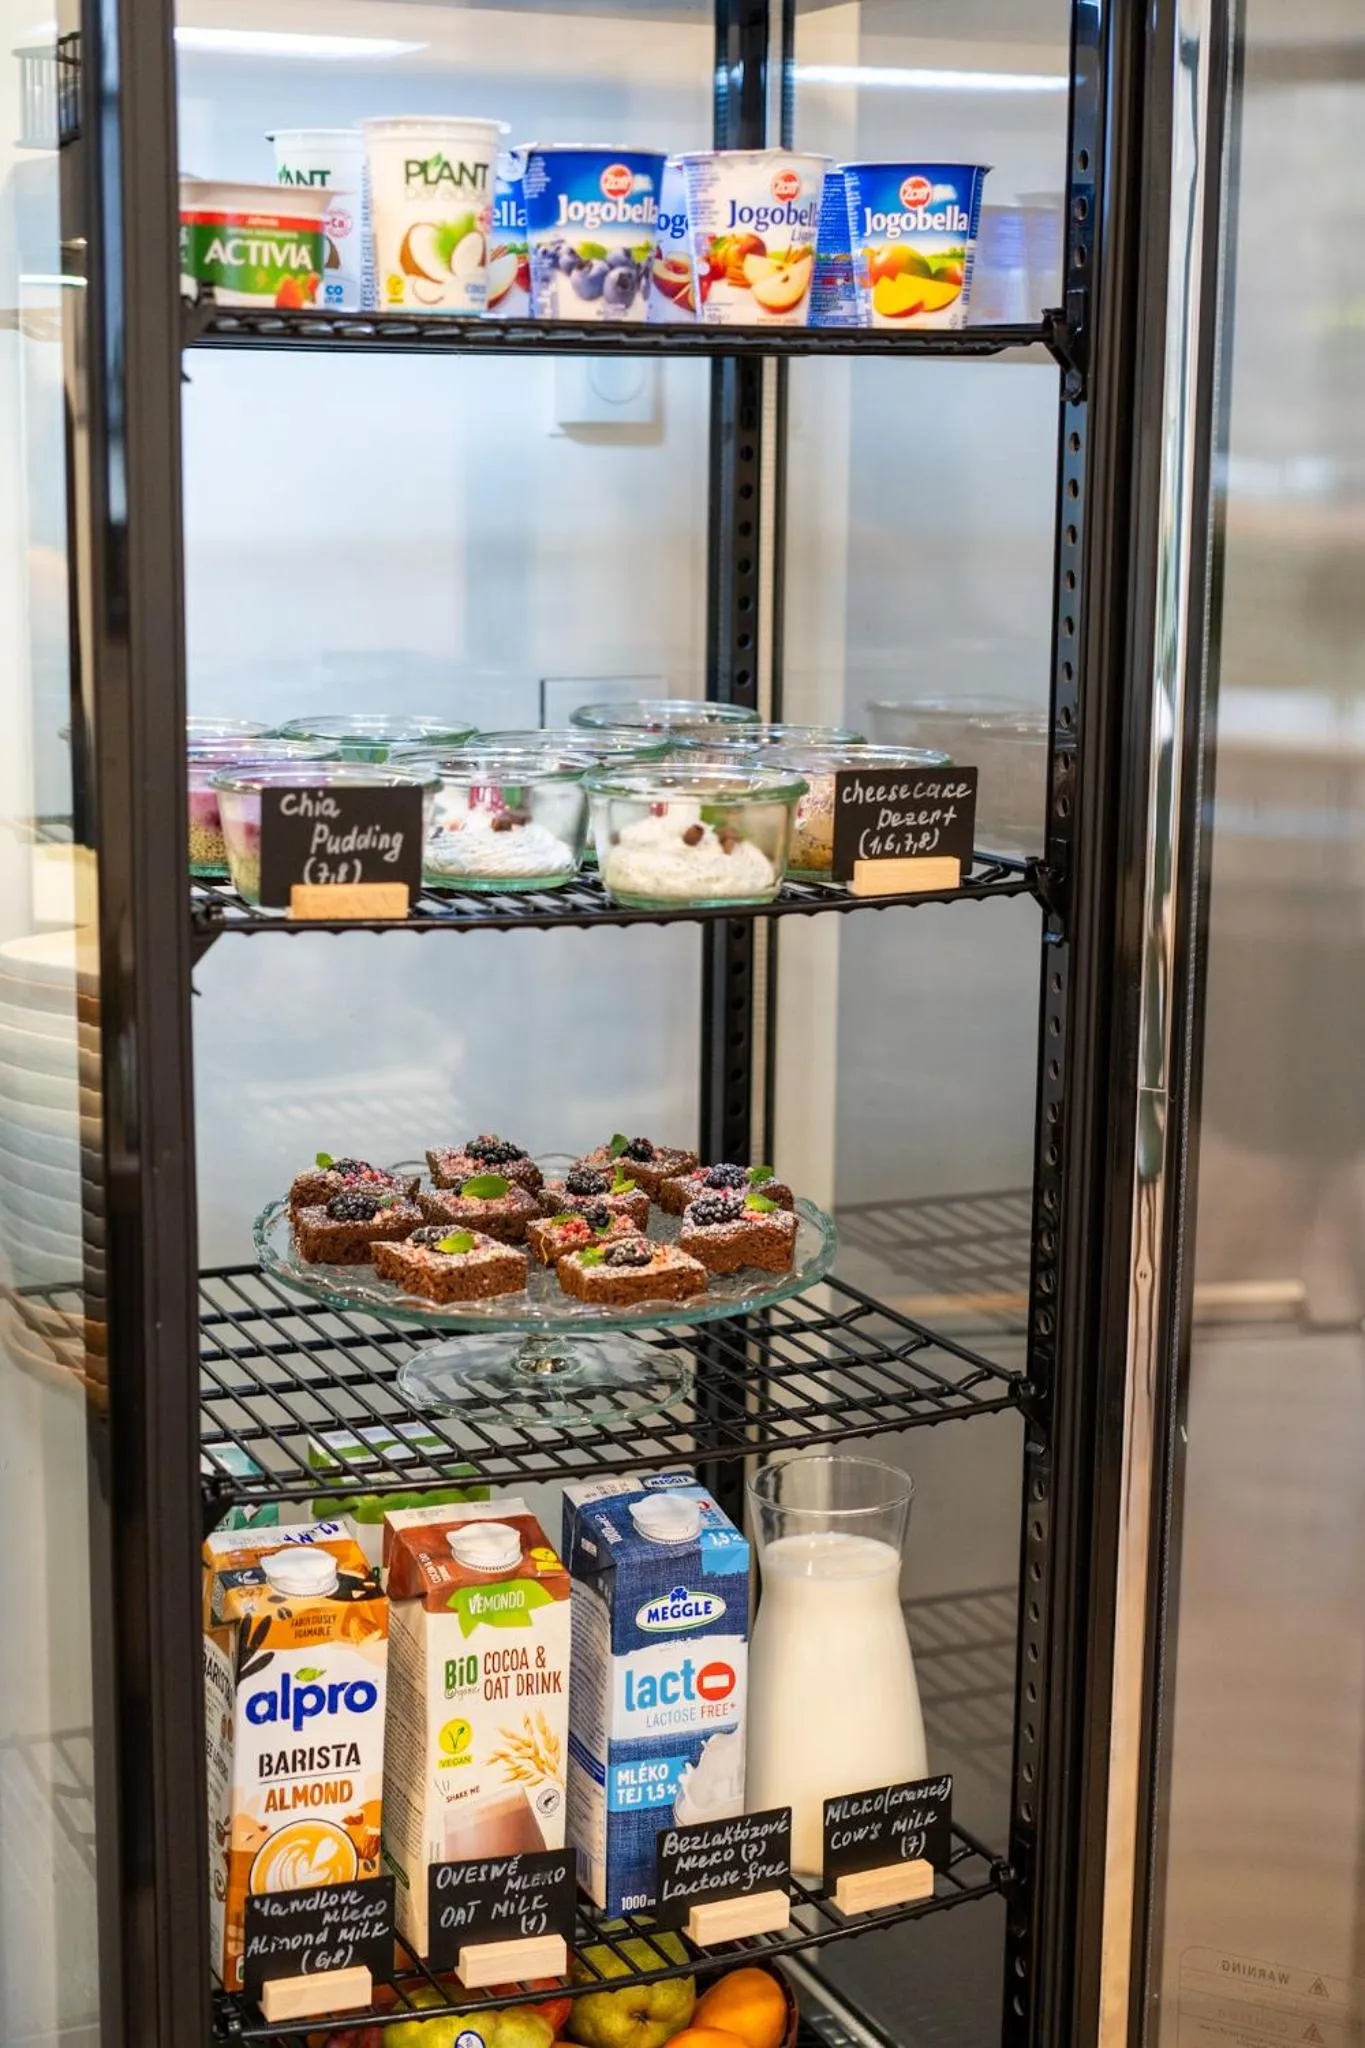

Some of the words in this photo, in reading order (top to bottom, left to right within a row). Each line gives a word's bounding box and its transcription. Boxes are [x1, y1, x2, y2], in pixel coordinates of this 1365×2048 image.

[279, 165, 331, 187] ANT
[405, 159, 489, 189] PLANT
[864, 205, 969, 239] Jogobella
[204, 237, 314, 270] ACTIVIA
[280, 791, 341, 818] Chia
[310, 822, 404, 862] Pudding
[469, 1590, 525, 1615] VEMONDO
[647, 1601, 712, 1624] MEGGLE
[484, 1647, 529, 1676] COCOA
[535, 1645, 546, 1668] &
[484, 1675, 511, 1701] OAT
[516, 1671, 562, 1697] DRINK
[245, 1672, 378, 1731] alpro
[646, 1708, 697, 1728] LACTOSE
[259, 1743, 361, 1777] BARISTA
[439, 1756, 472, 1769] VEGAN
[617, 1762, 669, 1786] MLÉKO
[264, 1780, 353, 1813] ALMOND
[617, 1788, 642, 1805] TEJ
[901, 1831, 926, 1858] (7)
[440, 1900, 481, 1928] OAT
[621, 1894, 648, 1911] 1000
